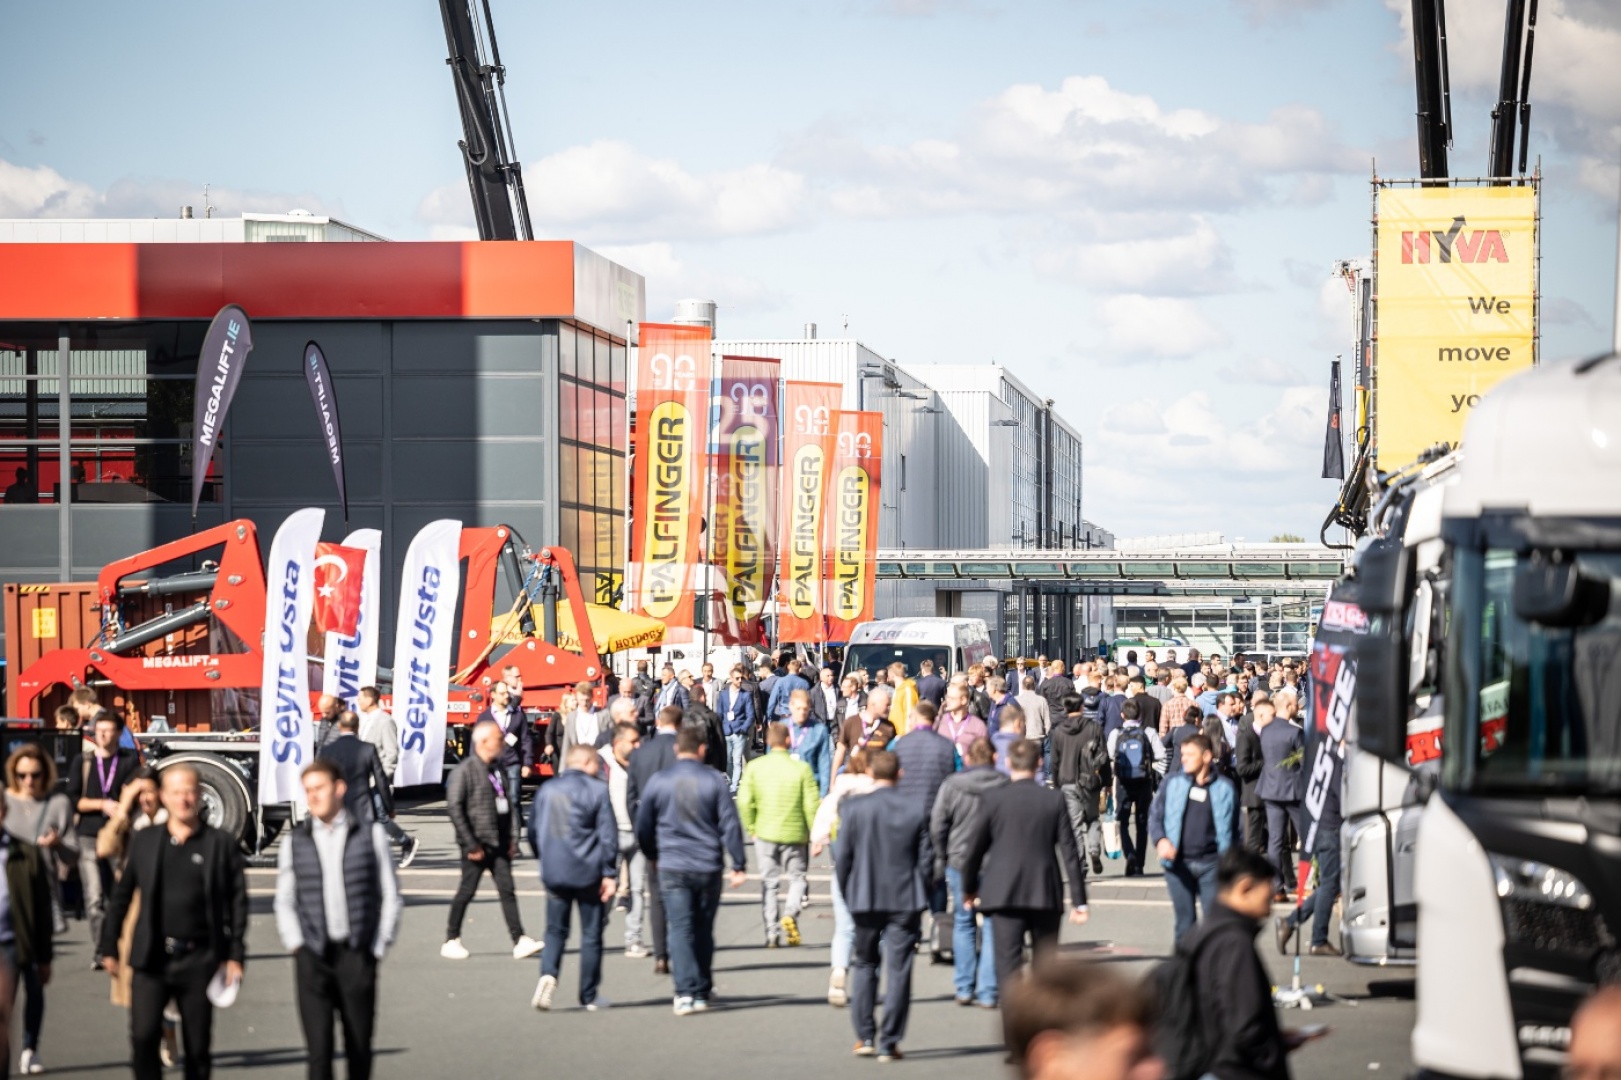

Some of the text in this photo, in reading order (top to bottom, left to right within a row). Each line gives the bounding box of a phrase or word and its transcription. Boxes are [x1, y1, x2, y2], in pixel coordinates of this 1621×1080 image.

[1401, 215, 1510, 264] HYVA
[1467, 296, 1511, 315] We
[199, 319, 241, 447] MEGALIFT.IE
[1438, 347, 1511, 362] move
[650, 417, 685, 603] PALFINGER
[732, 440, 760, 608] PALFINGER
[795, 455, 821, 606] PALFINGER
[838, 476, 863, 610] PALFINGER
[272, 560, 302, 765] Seyit Usta
[401, 566, 441, 754] Seyit Usta
